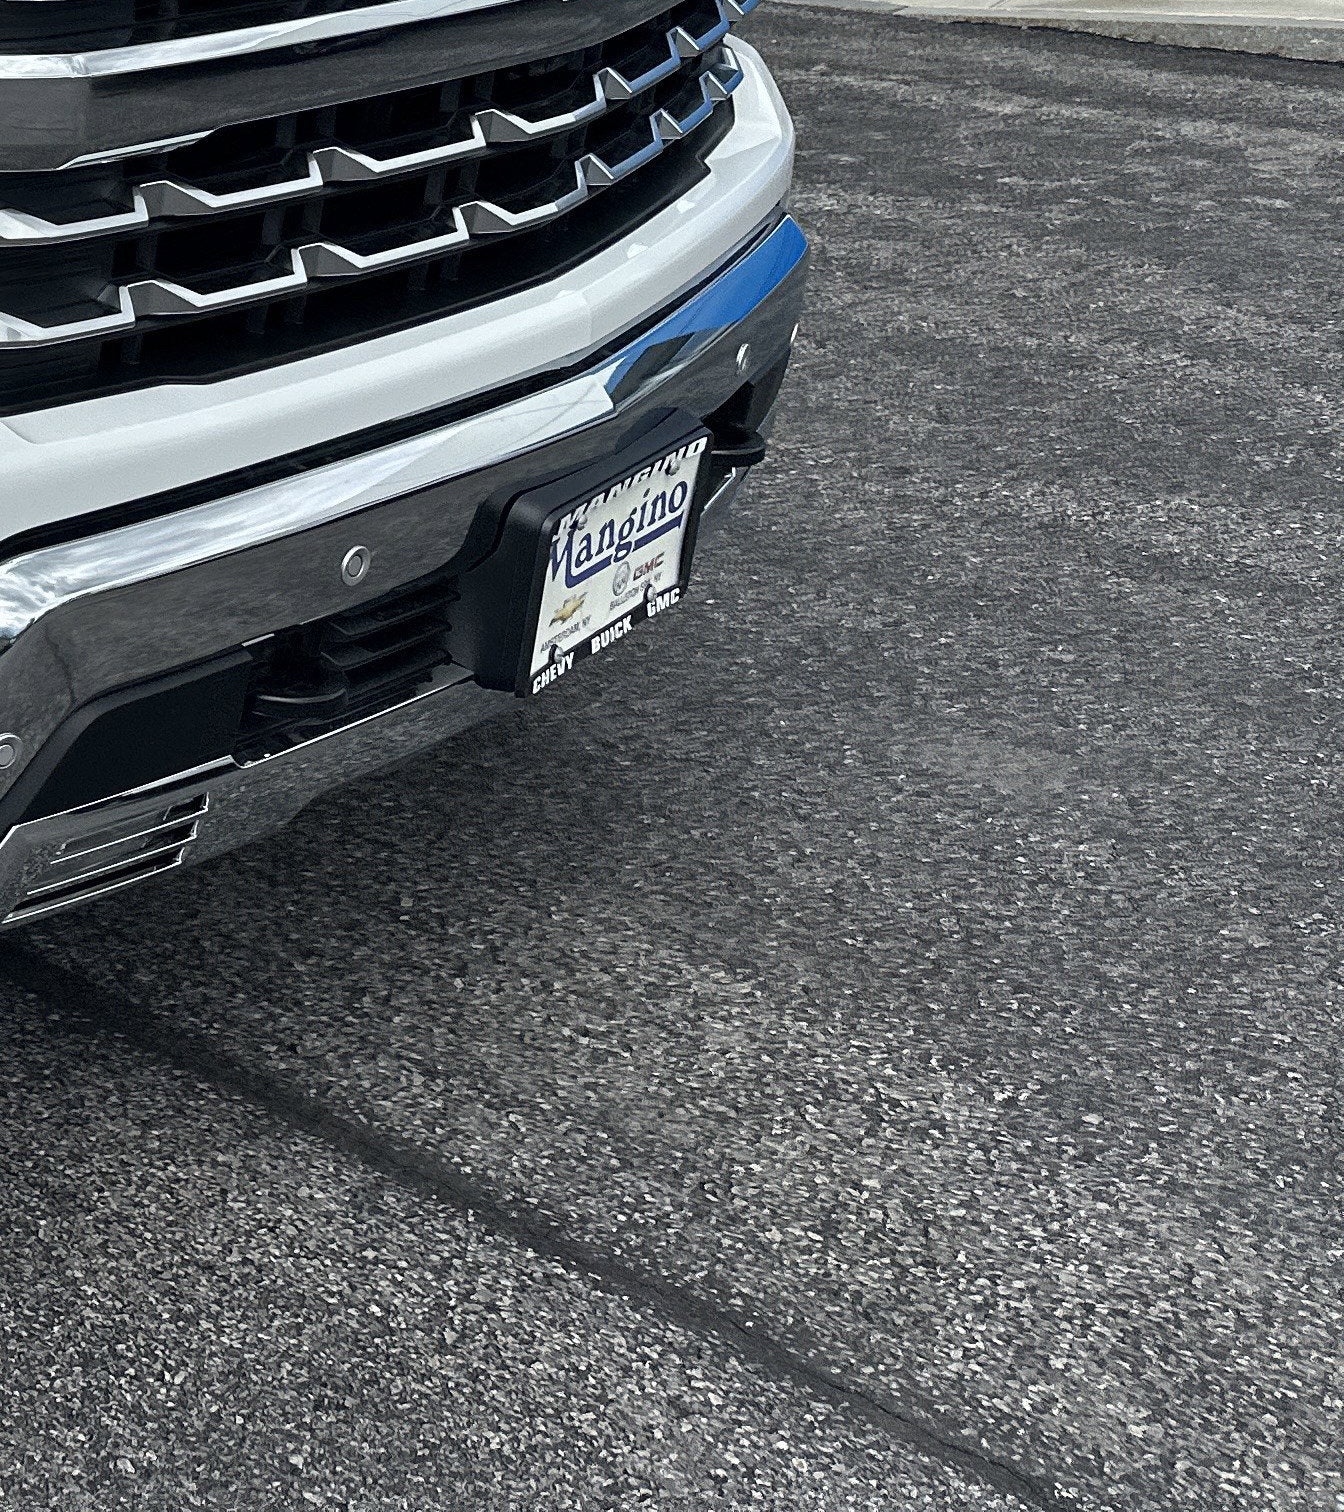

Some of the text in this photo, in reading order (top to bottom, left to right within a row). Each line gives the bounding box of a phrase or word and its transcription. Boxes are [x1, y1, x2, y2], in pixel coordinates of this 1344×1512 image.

[550, 480, 688, 587] Mangino
[633, 552, 665, 581] GMC
[532, 588, 680, 694] CHEVY BUICK GMC
